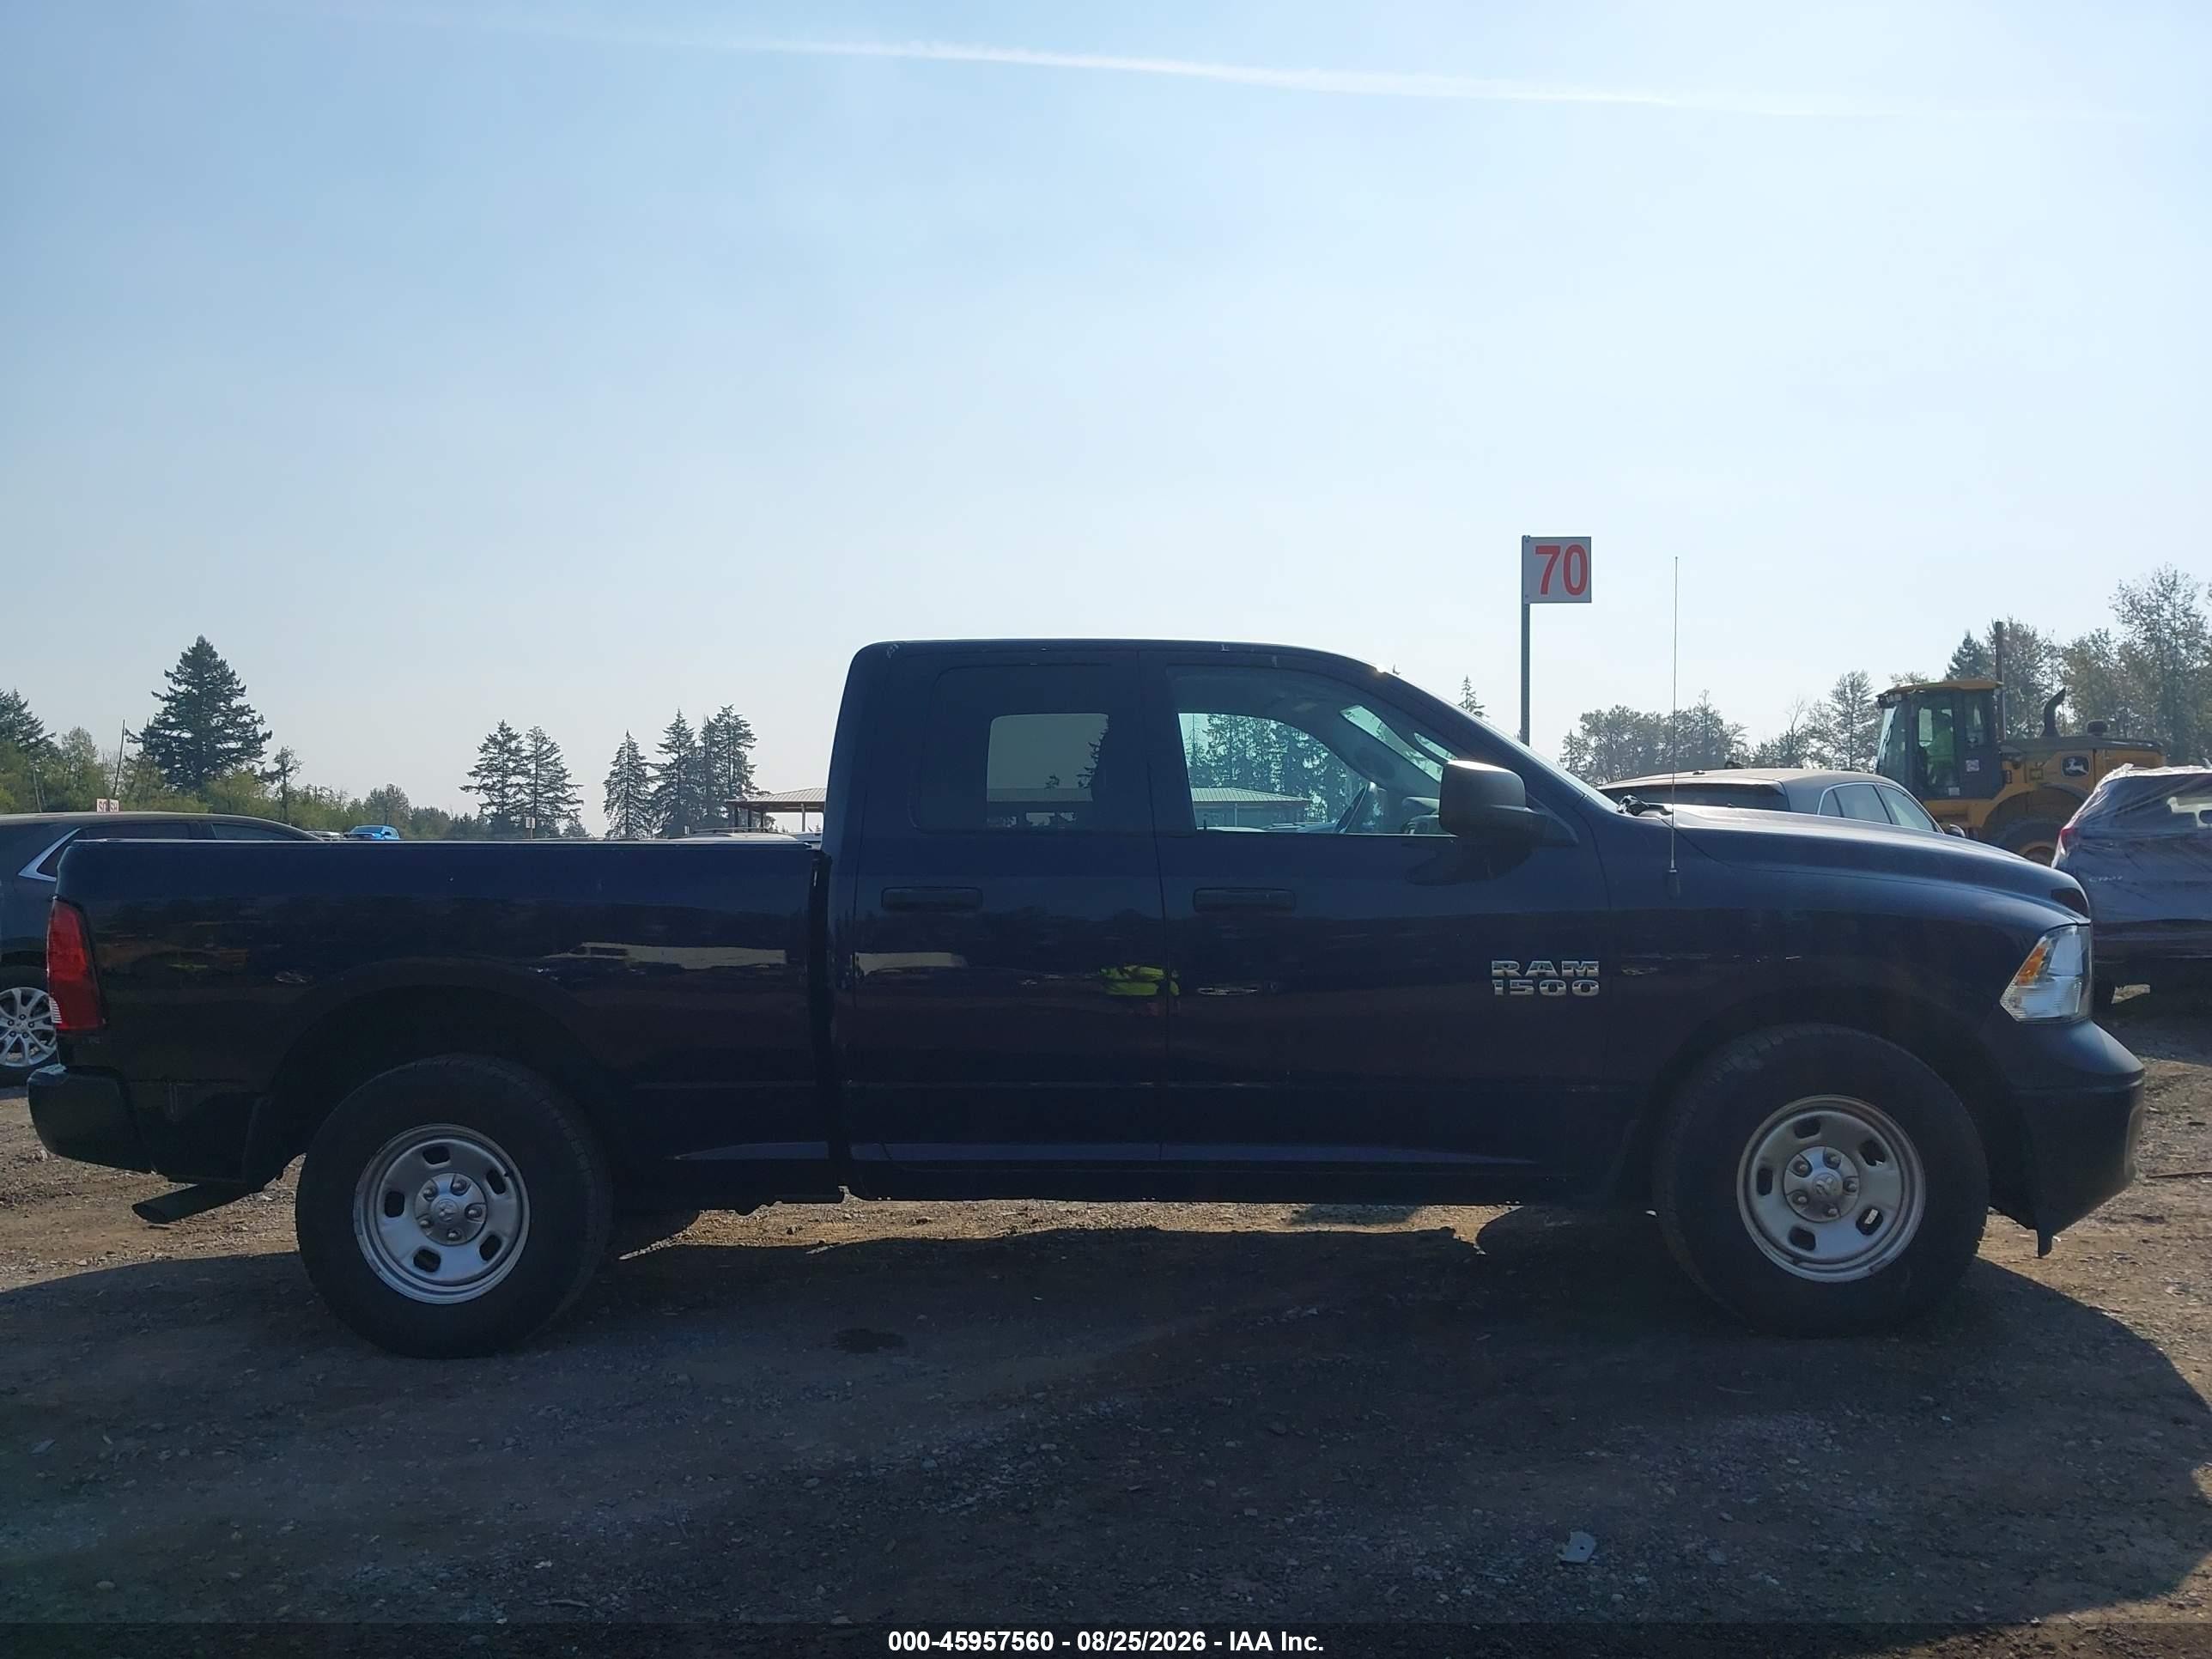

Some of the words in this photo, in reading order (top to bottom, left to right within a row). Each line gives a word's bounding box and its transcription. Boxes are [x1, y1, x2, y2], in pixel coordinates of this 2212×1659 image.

[1534, 544, 1588, 596] 70
[1491, 960, 1600, 977] RAM
[1491, 979, 1601, 997] 1500
